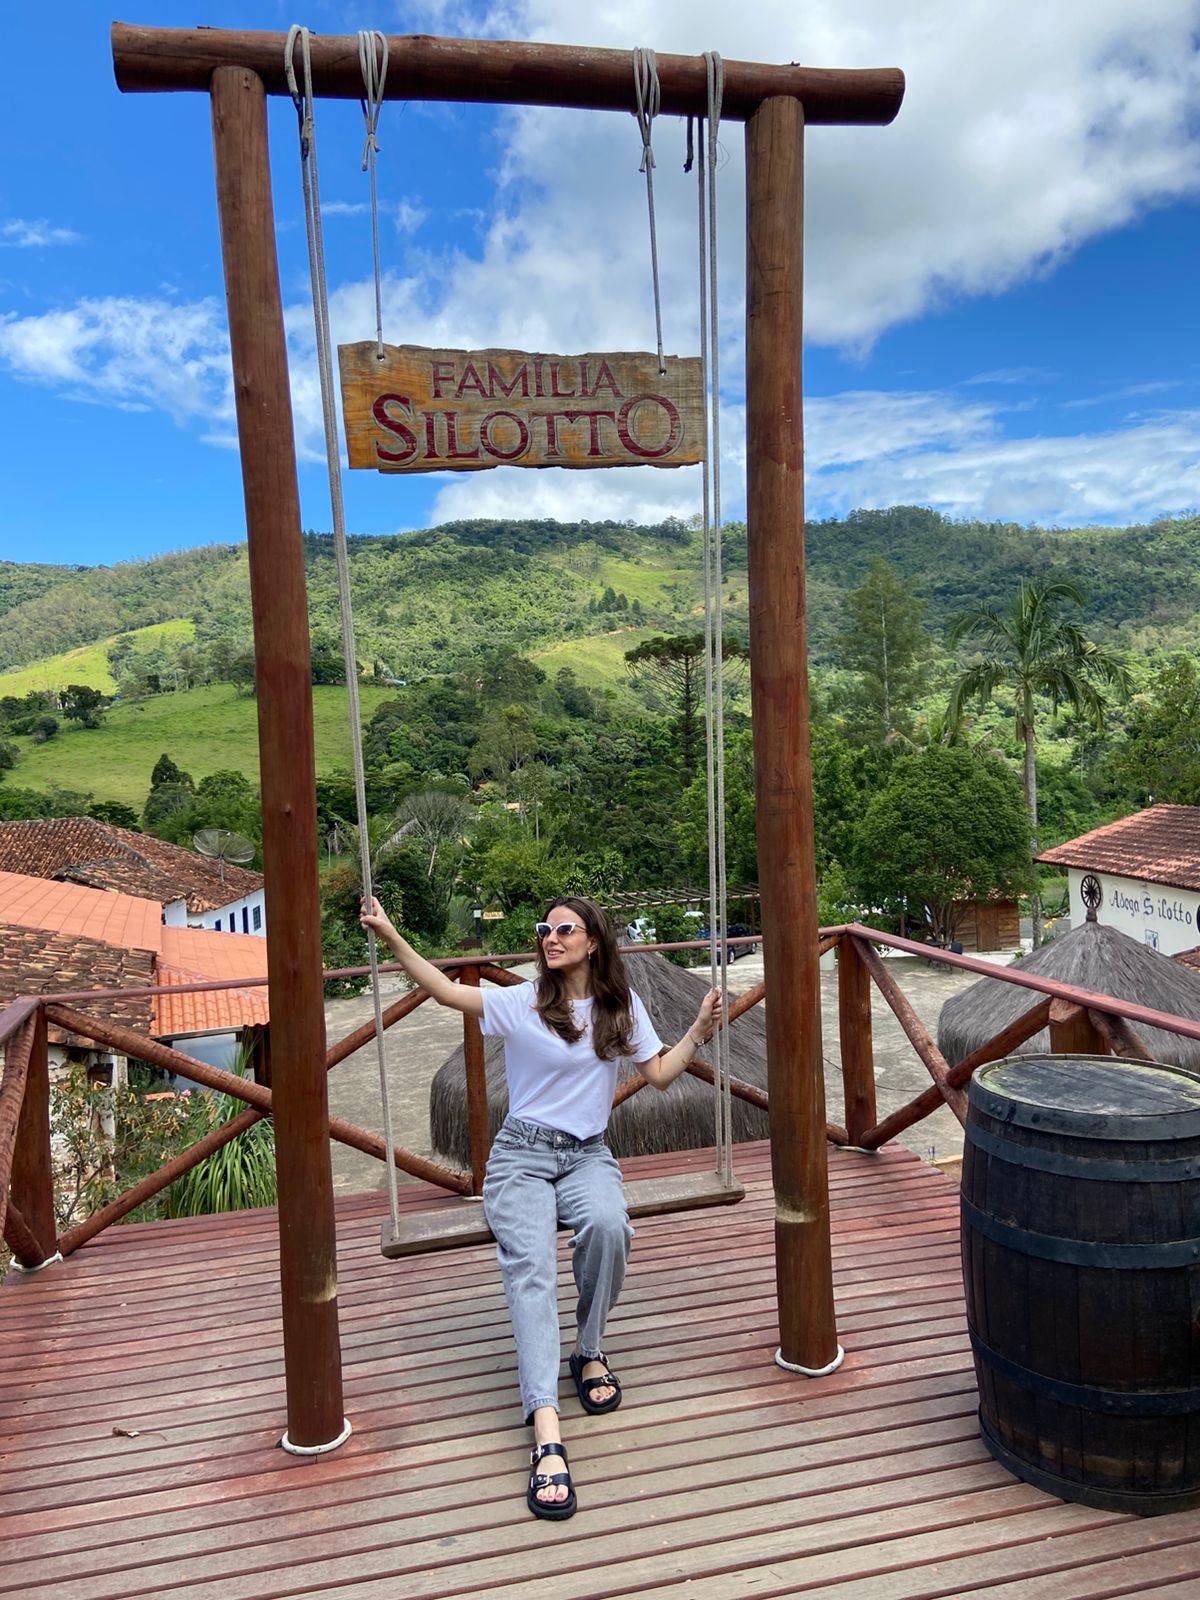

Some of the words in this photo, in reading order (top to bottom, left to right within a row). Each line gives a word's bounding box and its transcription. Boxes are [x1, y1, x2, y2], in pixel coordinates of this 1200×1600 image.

[371, 393, 682, 461] SILOTTO
[1110, 890, 1140, 917] Adega
[1143, 897, 1192, 925] Silotto
